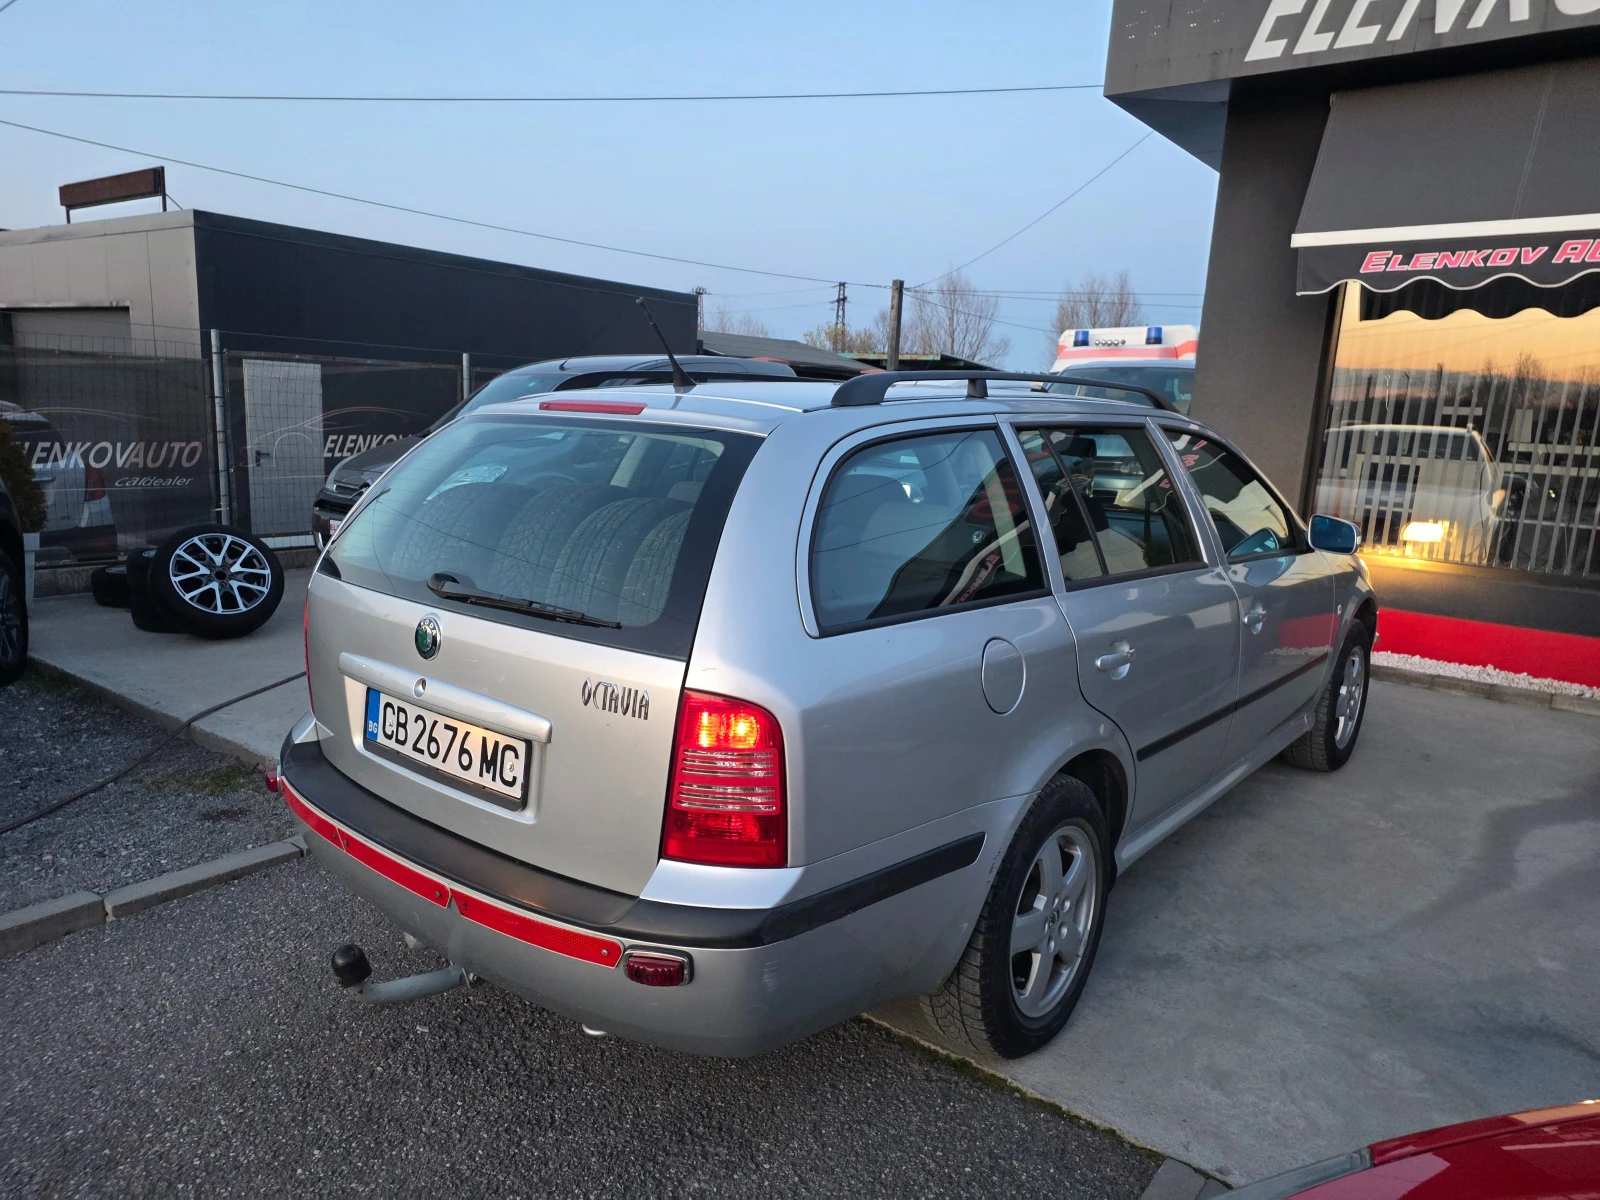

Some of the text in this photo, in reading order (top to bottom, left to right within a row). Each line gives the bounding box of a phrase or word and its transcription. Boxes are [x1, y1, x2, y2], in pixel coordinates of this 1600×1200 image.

[1360, 246, 1548, 273] ELENKOV
[581, 677, 650, 720] OCTAVIA
[368, 720, 378, 733] BG
[382, 701, 519, 787] CB 2676 MC
